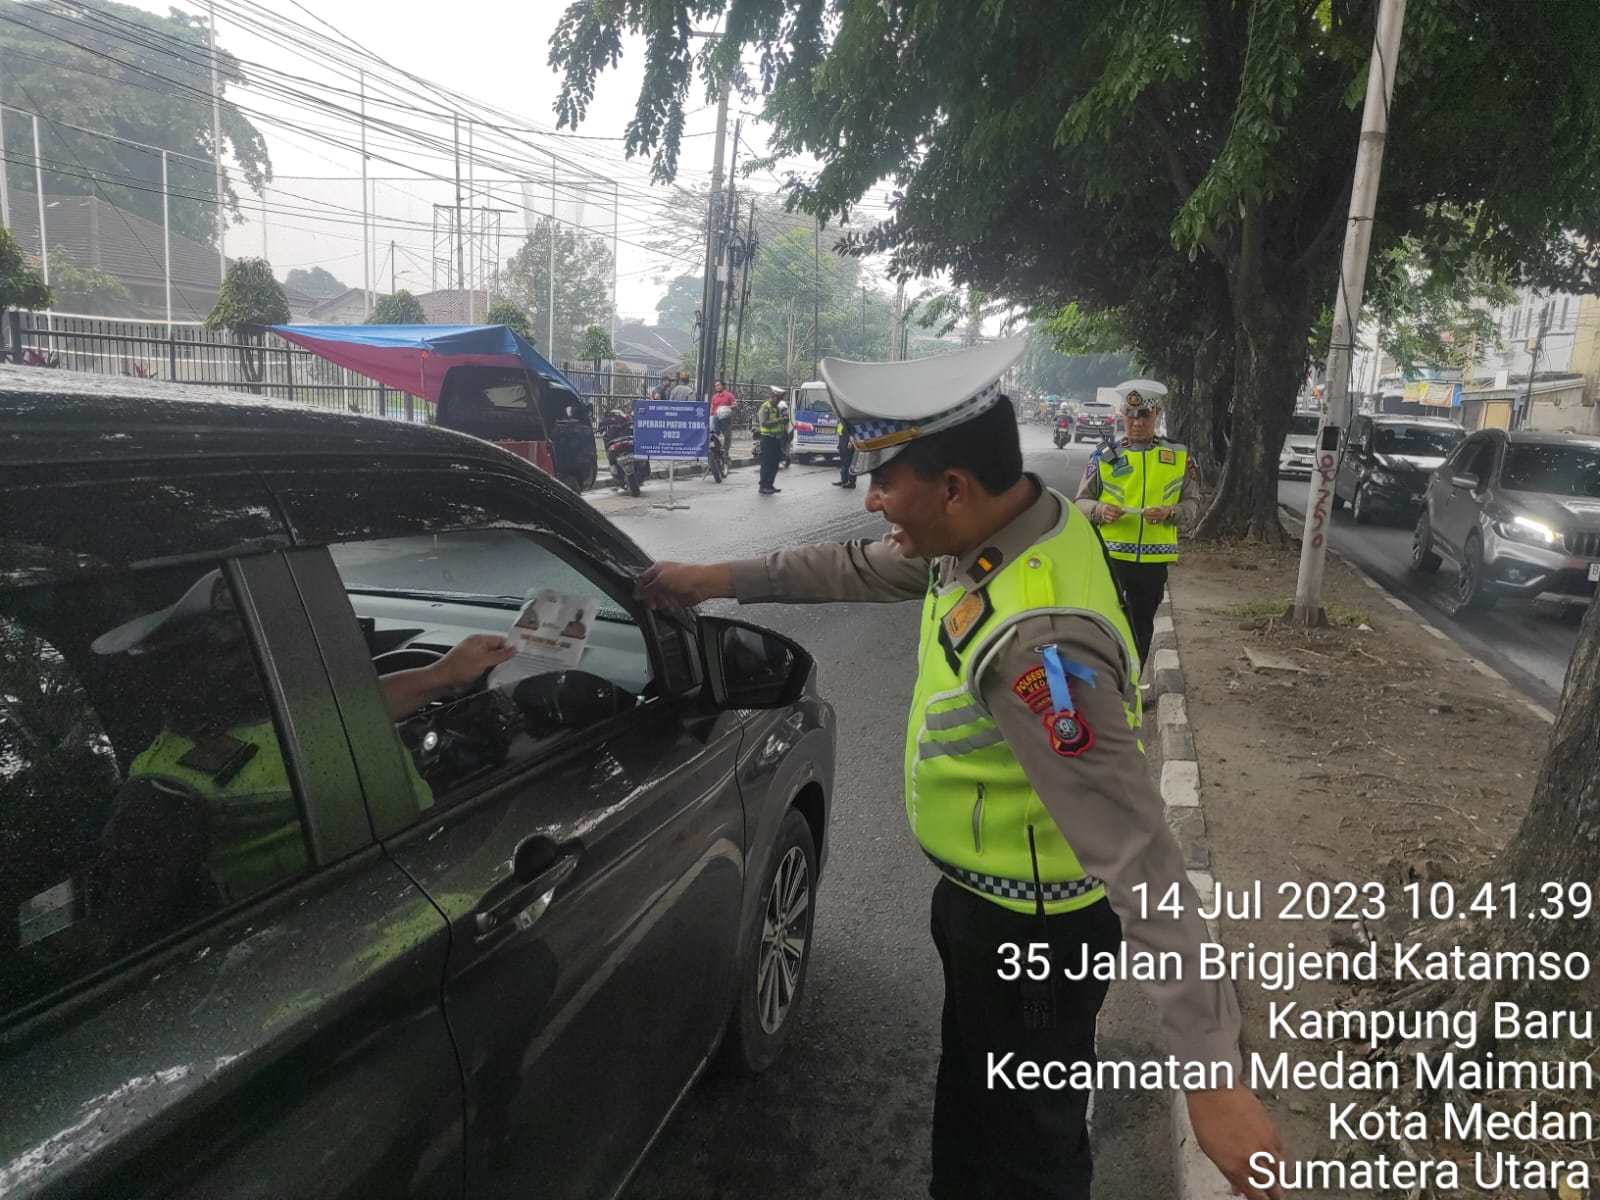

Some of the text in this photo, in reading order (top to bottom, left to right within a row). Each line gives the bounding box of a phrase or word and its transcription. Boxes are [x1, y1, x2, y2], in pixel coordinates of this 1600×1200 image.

[637, 420, 706, 429] OPERASI PATUH TOBA
[662, 431, 680, 439] 2023
[1015, 668, 1048, 694] POLREST
[1027, 680, 1049, 693] MED
